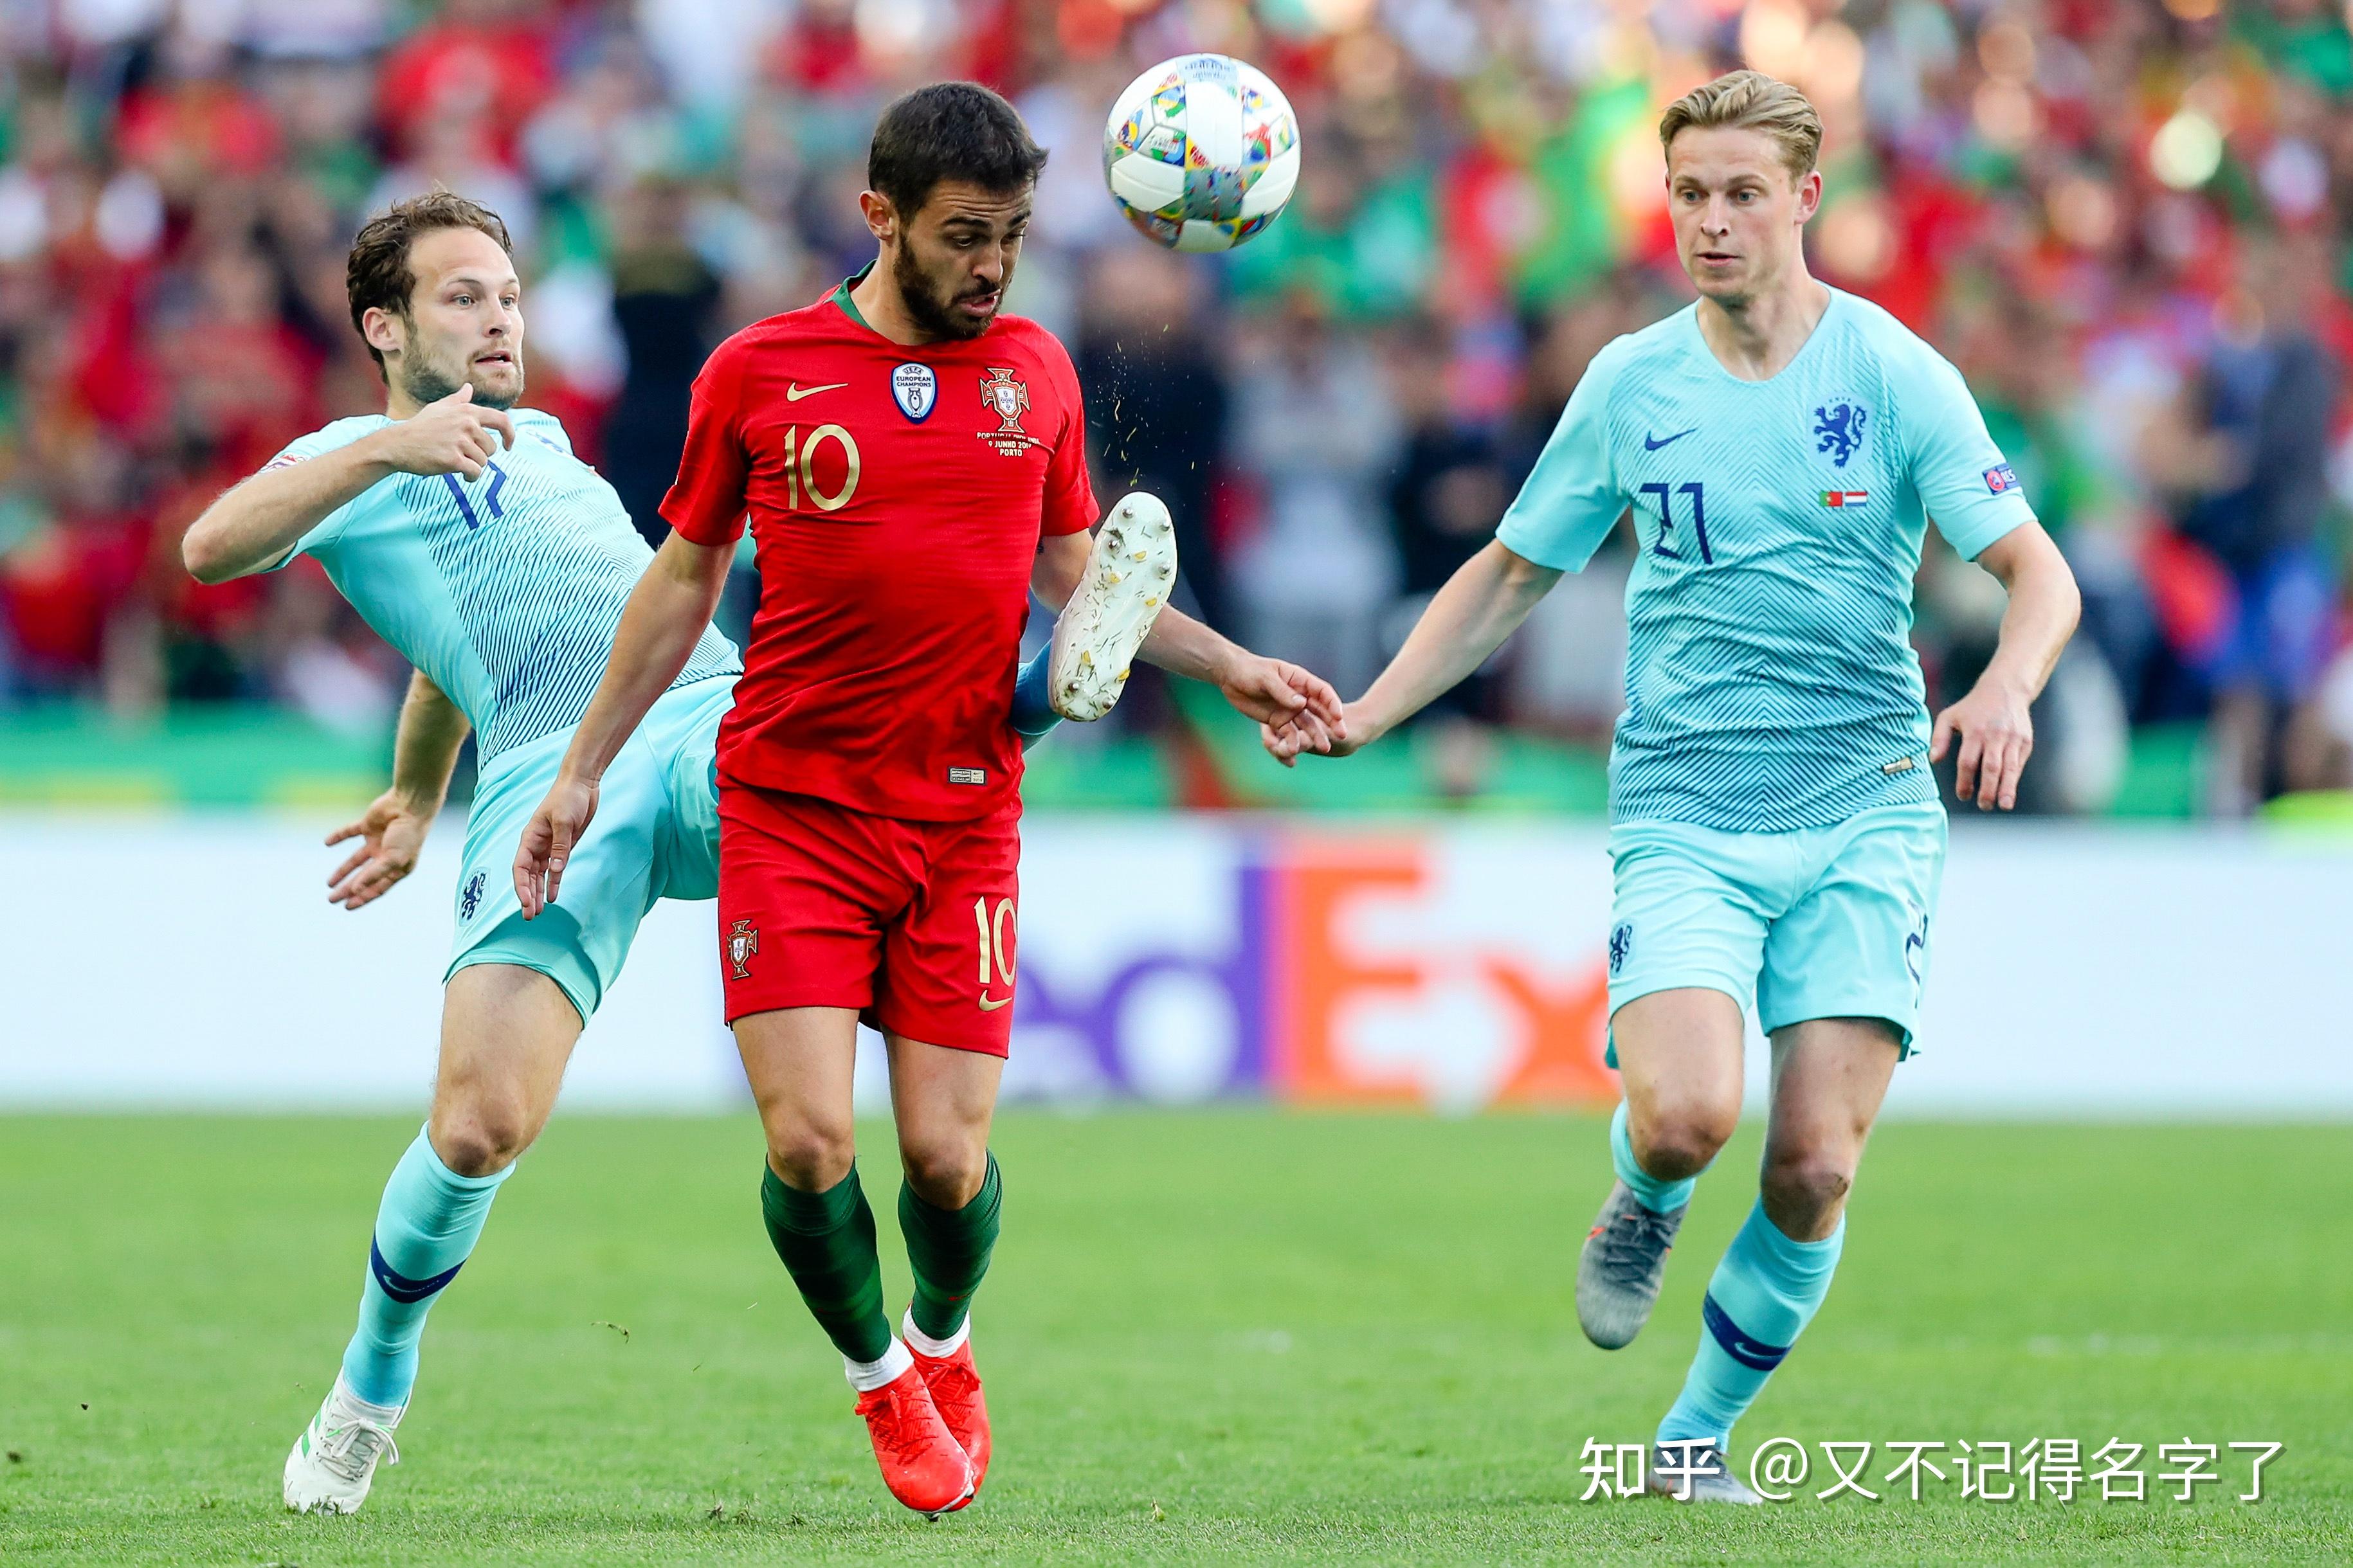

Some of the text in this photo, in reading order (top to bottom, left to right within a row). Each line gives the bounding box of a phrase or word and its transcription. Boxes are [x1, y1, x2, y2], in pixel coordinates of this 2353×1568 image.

[904, 366, 923, 374] UEFA
[784, 424, 860, 511] 10
[999, 448, 1022, 456] PORTO
[974, 896, 1017, 987] 10
